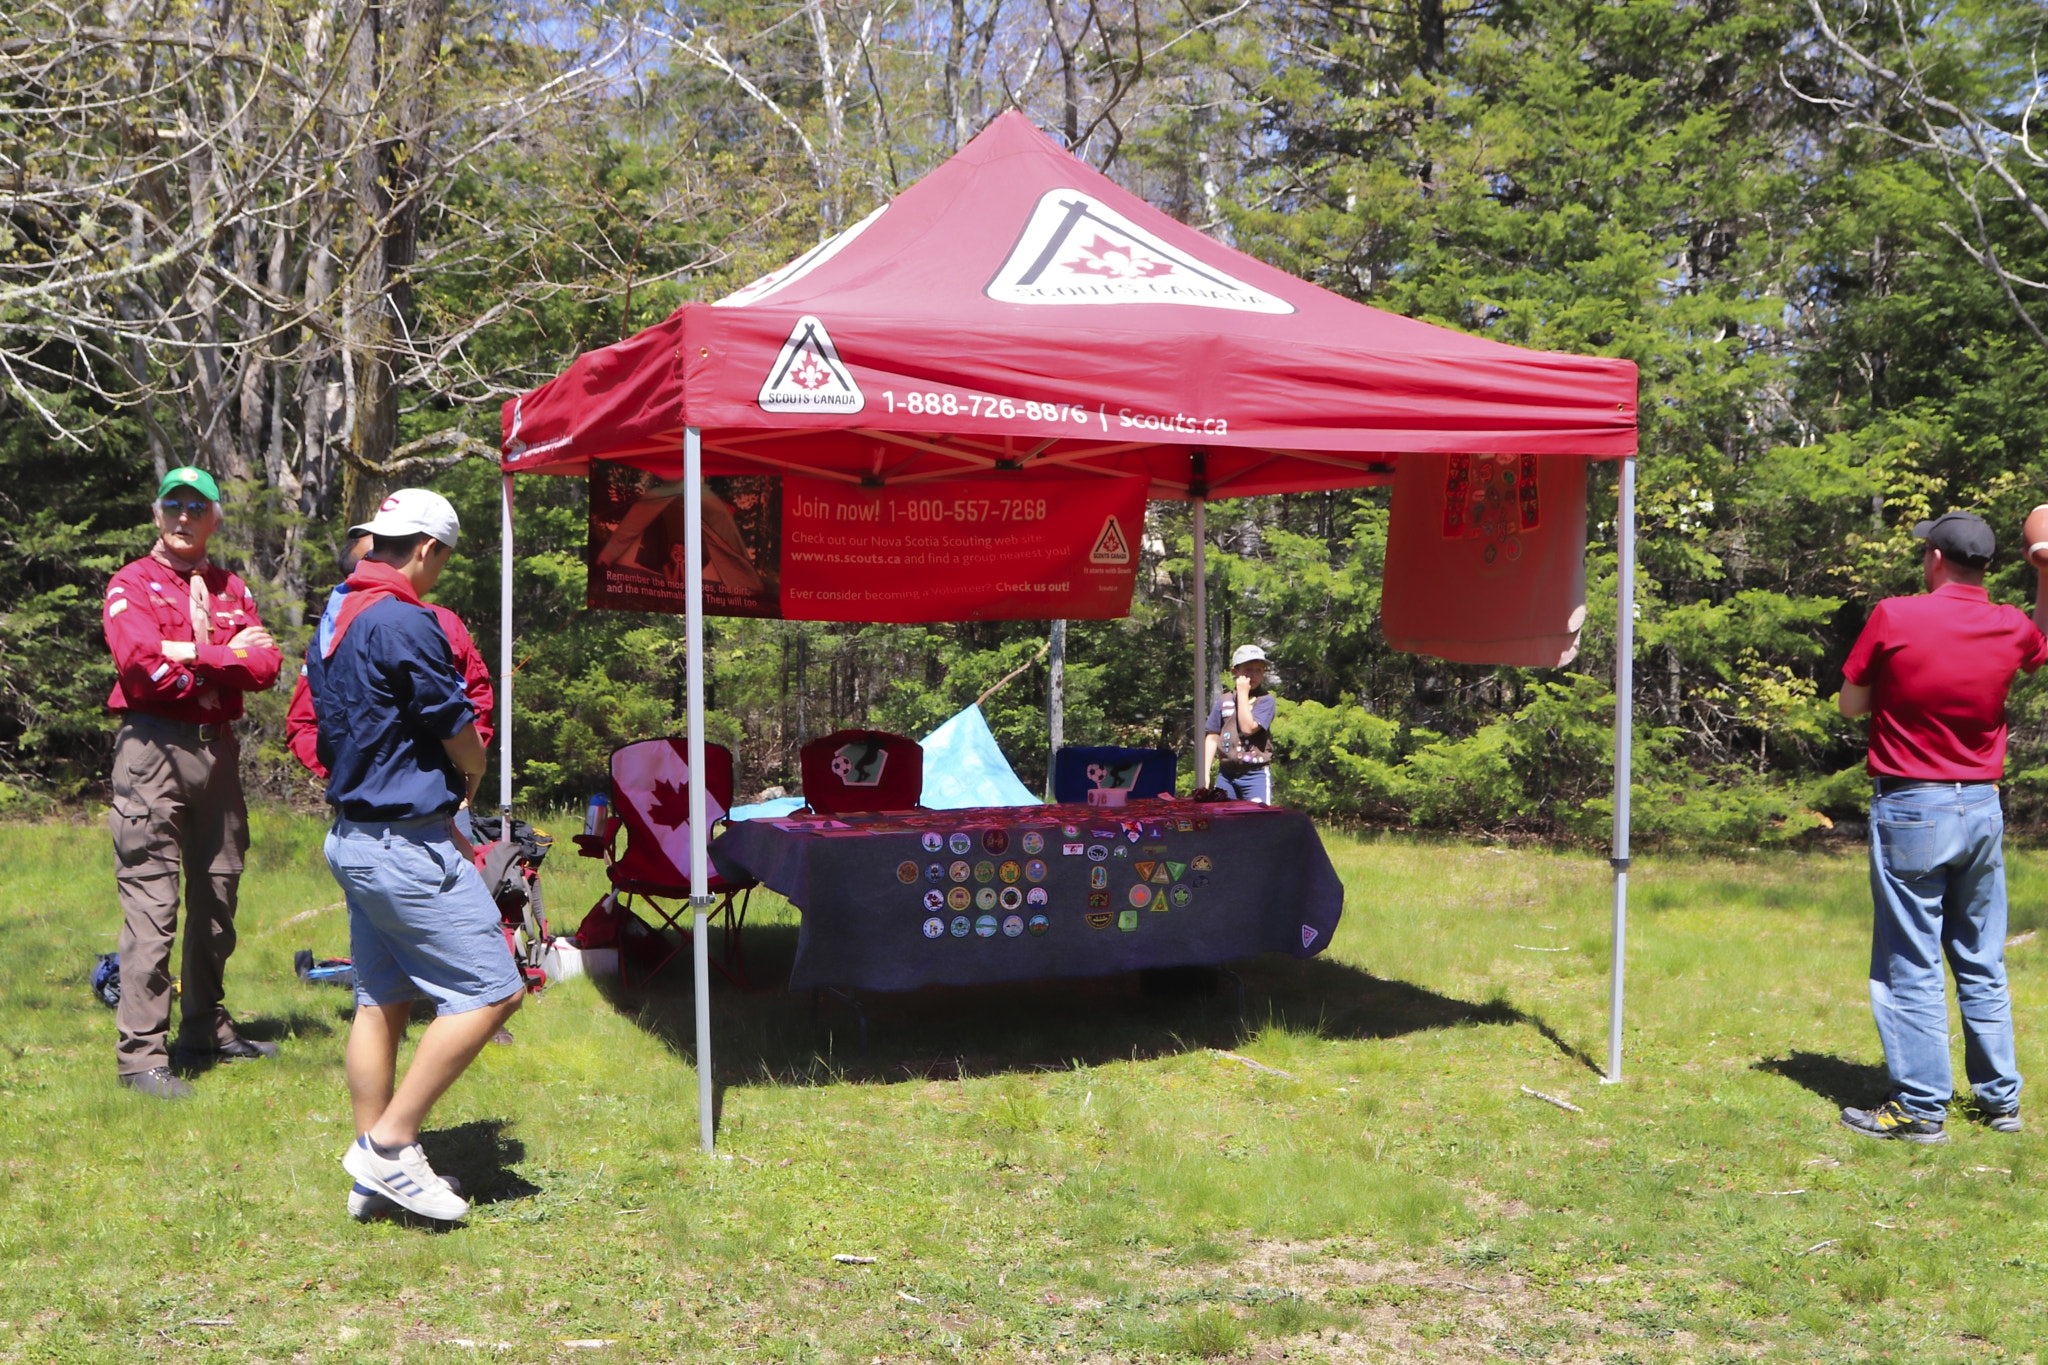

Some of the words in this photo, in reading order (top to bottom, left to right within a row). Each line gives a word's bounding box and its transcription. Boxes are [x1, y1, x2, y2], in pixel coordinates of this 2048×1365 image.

[768, 392, 810, 404] SCOUTS
[813, 393, 856, 405] CANADA
[882, 390, 1088, 425] 1-888-726-8876
[1119, 407, 1228, 436] Scouts.ca
[380, 496, 400, 512] C
[792, 495, 830, 520] Join
[836, 500, 880, 522] now!
[888, 498, 1047, 523] 1-800-557-7268
[791, 531, 825, 545] Check
[827, 535, 847, 546] out
[849, 537, 868, 547] our
[871, 536, 901, 547] Nova
[904, 535, 940, 547] Scotia
[942, 535, 992, 549] Scouting
[994, 534, 1018, 546] web
[791, 551, 901, 565] www.ns.scouts.ca
[904, 553, 925, 565] and
[928, 552, 949, 564] find
[953, 555, 960, 564] a
[962, 552, 996, 566] group
[1000, 549, 1041, 560] nearest
[1045, 546, 1071, 560] you!
[606, 570, 650, 584] Remember
[652, 577, 666, 587] the
[606, 584, 623, 593] and
[625, 583, 639, 594] the
[705, 593, 726, 607] They
[728, 596, 742, 607] will
[790, 588, 814, 599] Ever
[816, 589, 862, 601] consider
[865, 589, 920, 601] becoming
[931, 583, 992, 595] Volunteer?
[996, 580, 1031, 592] Check
[1034, 583, 1046, 592] us
[1048, 581, 1070, 592] out!
